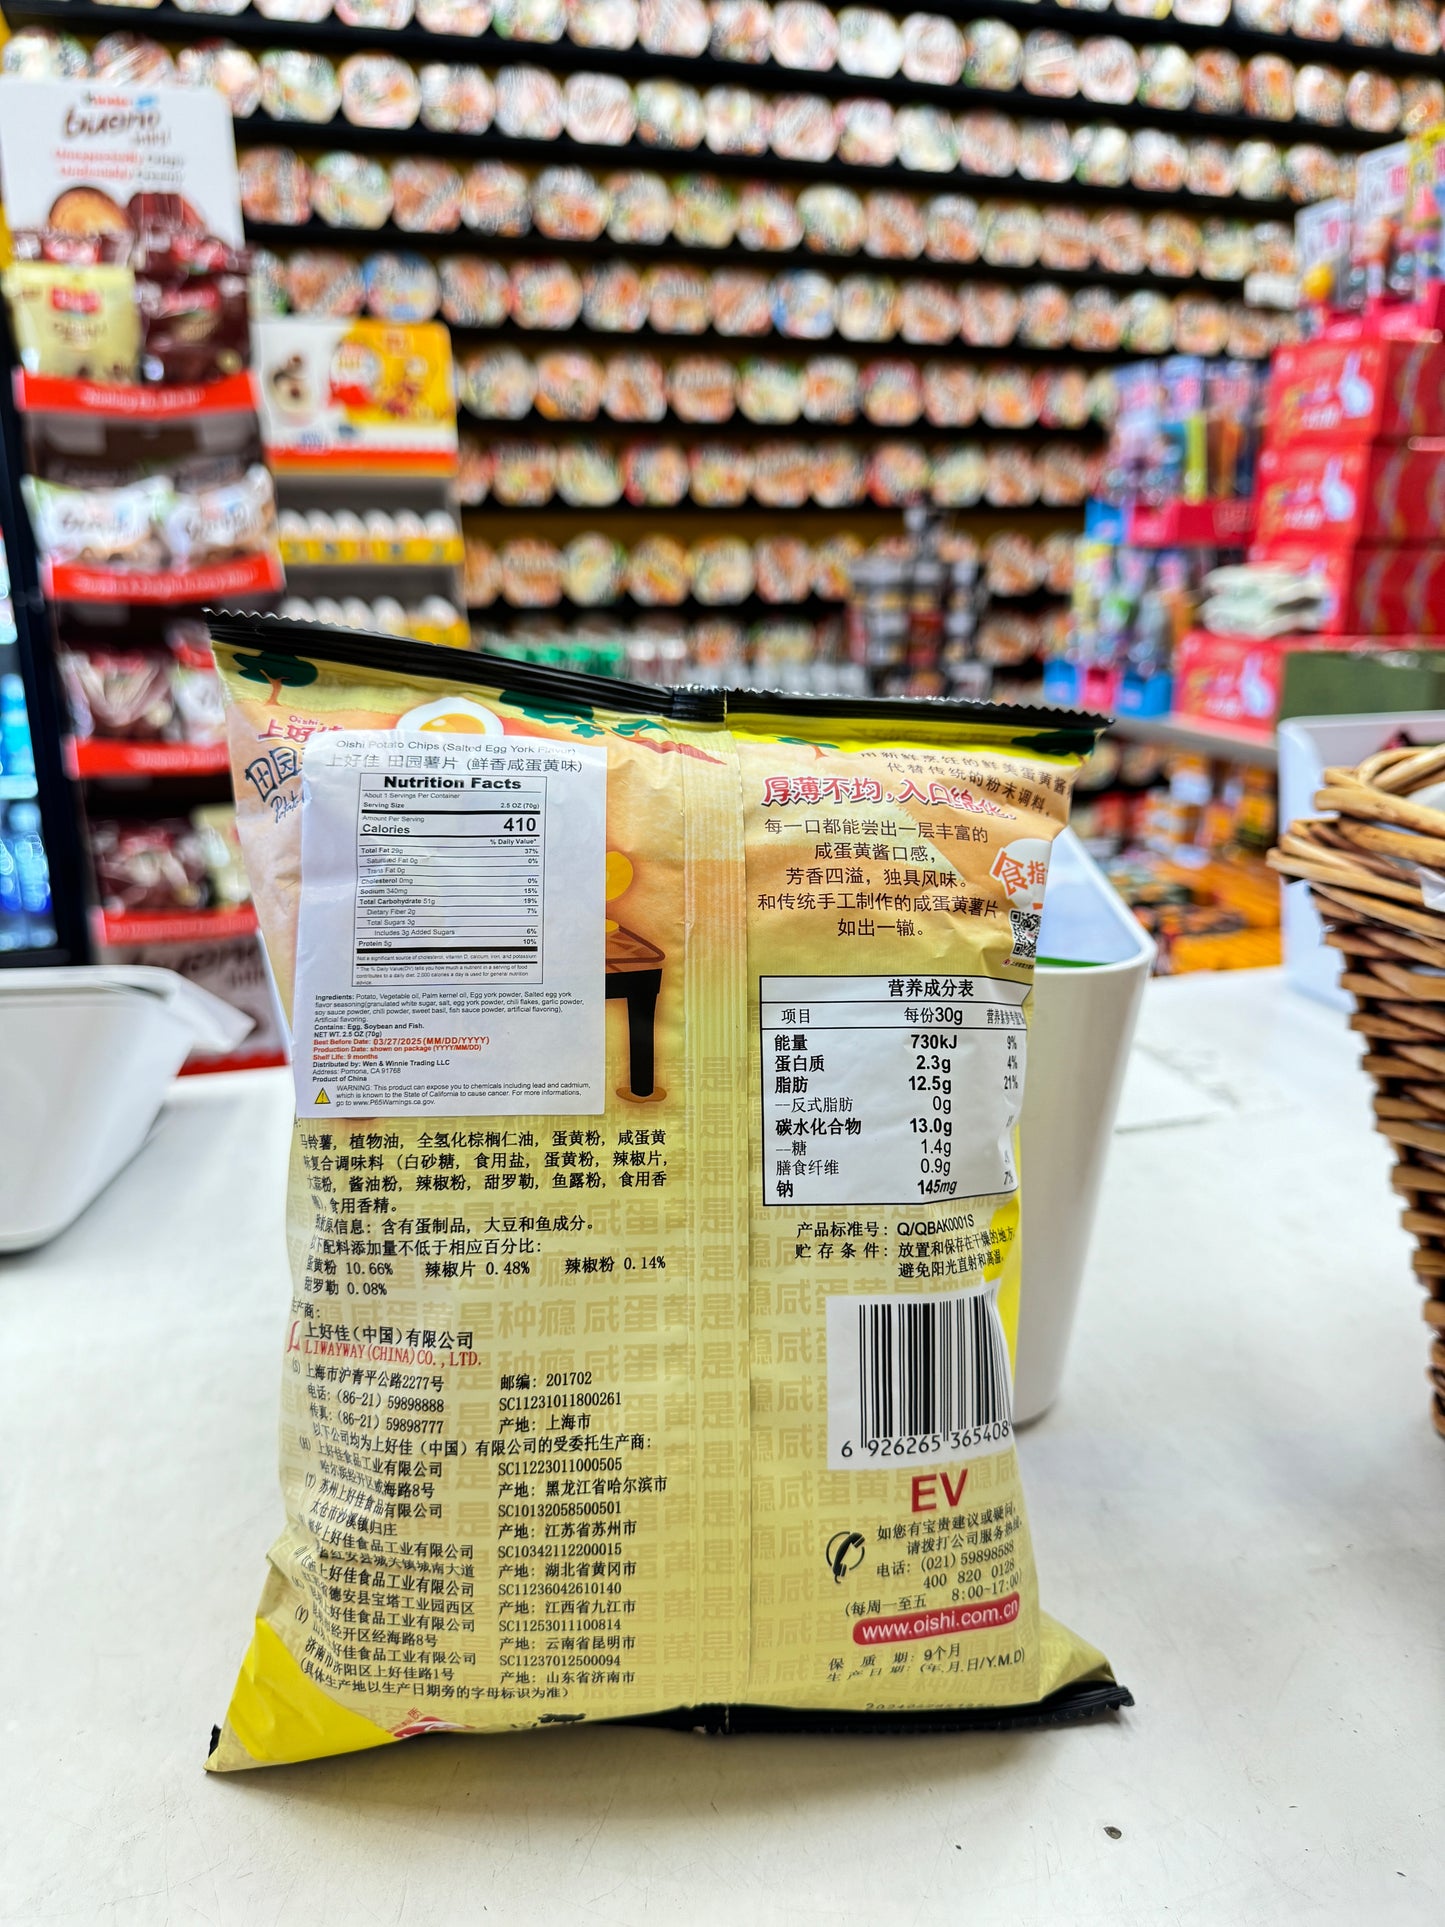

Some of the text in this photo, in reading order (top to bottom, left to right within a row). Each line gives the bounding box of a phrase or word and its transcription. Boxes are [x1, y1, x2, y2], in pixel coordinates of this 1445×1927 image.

[289, 715, 318, 725] Oishi
[257, 717, 343, 743] 上好
[336, 740, 365, 748] Oishi
[368, 740, 404, 749] Potato
[408, 741, 440, 751] Chips
[443, 743, 482, 752] (Salted
[485, 745, 507, 754] Egg
[510, 745, 534, 753] York
[326, 753, 380, 768] 上好佳
[388, 755, 459, 770] 田园薯片
[245, 747, 298, 802] 田园
[384, 776, 522, 789] Nutrition Facts
[362, 824, 410, 834] Calories
[503, 817, 537, 832] 410
[764, 818, 988, 843] 每一口都能尝出一层丰富的
[757, 893, 999, 919] 和传统手工制作的咸蛋黄薯片
[837, 918, 927, 937] 如出一辙。
[888, 979, 975, 997] 营养成分表
[781, 1008, 811, 1024] 项目
[903, 1006, 963, 1024] 每份30g
[774, 1035, 808, 1051] 能量
[910, 1034, 958, 1050] 730kJ
[1007, 1035, 1018, 1050] 9%
[774, 1055, 825, 1072] 蛋白质
[916, 1054, 951, 1073] 2.3g
[1007, 1055, 1018, 1070] 4%
[774, 1075, 808, 1093] 脂肪
[908, 1075, 952, 1094] 12.5g
[1004, 1075, 1018, 1090] 21%
[932, 1097, 952, 1114] 0g
[775, 1118, 862, 1136] 碳水化合物
[909, 1118, 953, 1137] 13.0g
[920, 1139, 952, 1157] 1.4g
[776, 1160, 840, 1176] 膳食纤维
[920, 1158, 951, 1176] 0.9g
[777, 1180, 794, 1197] 钠
[917, 1179, 958, 1195] 145mg
[896, 1213, 975, 1235] Q/QBAK0001S
[346, 1262, 393, 1275] 10.66%
[425, 1261, 475, 1278] 辣椒片
[486, 1260, 530, 1276] 0.48%
[565, 1256, 615, 1274] 辣椒粉
[624, 1256, 666, 1270] 0.14%
[347, 1282, 387, 1296] 0.08%
[546, 1372, 592, 1387] 201702
[499, 1392, 622, 1411] SC11231011800261
[546, 1412, 591, 1431] 上海市
[841, 1420, 1010, 1458] 6 926265 365408
[498, 1457, 622, 1476] SC11223011000505
[545, 1475, 667, 1497] 黑龙江省哈尔滨市
[911, 1468, 968, 1512] EV
[498, 1501, 621, 1517] SC10132058500501
[545, 1519, 637, 1538] 江苏省苏州市
[498, 1543, 622, 1558] SC10342112200015
[920, 1552, 956, 1572] (021)
[960, 1542, 1015, 1566] 59898588
[545, 1561, 637, 1577] 湖北省黄冈市
[923, 1559, 1015, 1590] 400 820 0128
[499, 1582, 621, 1596] SC11236042610140
[545, 1599, 636, 1615] 江西省九江市
[499, 1619, 621, 1632] SC11253011100814
[862, 1598, 1018, 1640] www.oishi.com.cn
[546, 1636, 636, 1650] 云南省昆明市
[500, 1655, 620, 1667] SC11237012500094
[546, 1671, 636, 1684] 山东省济南市
